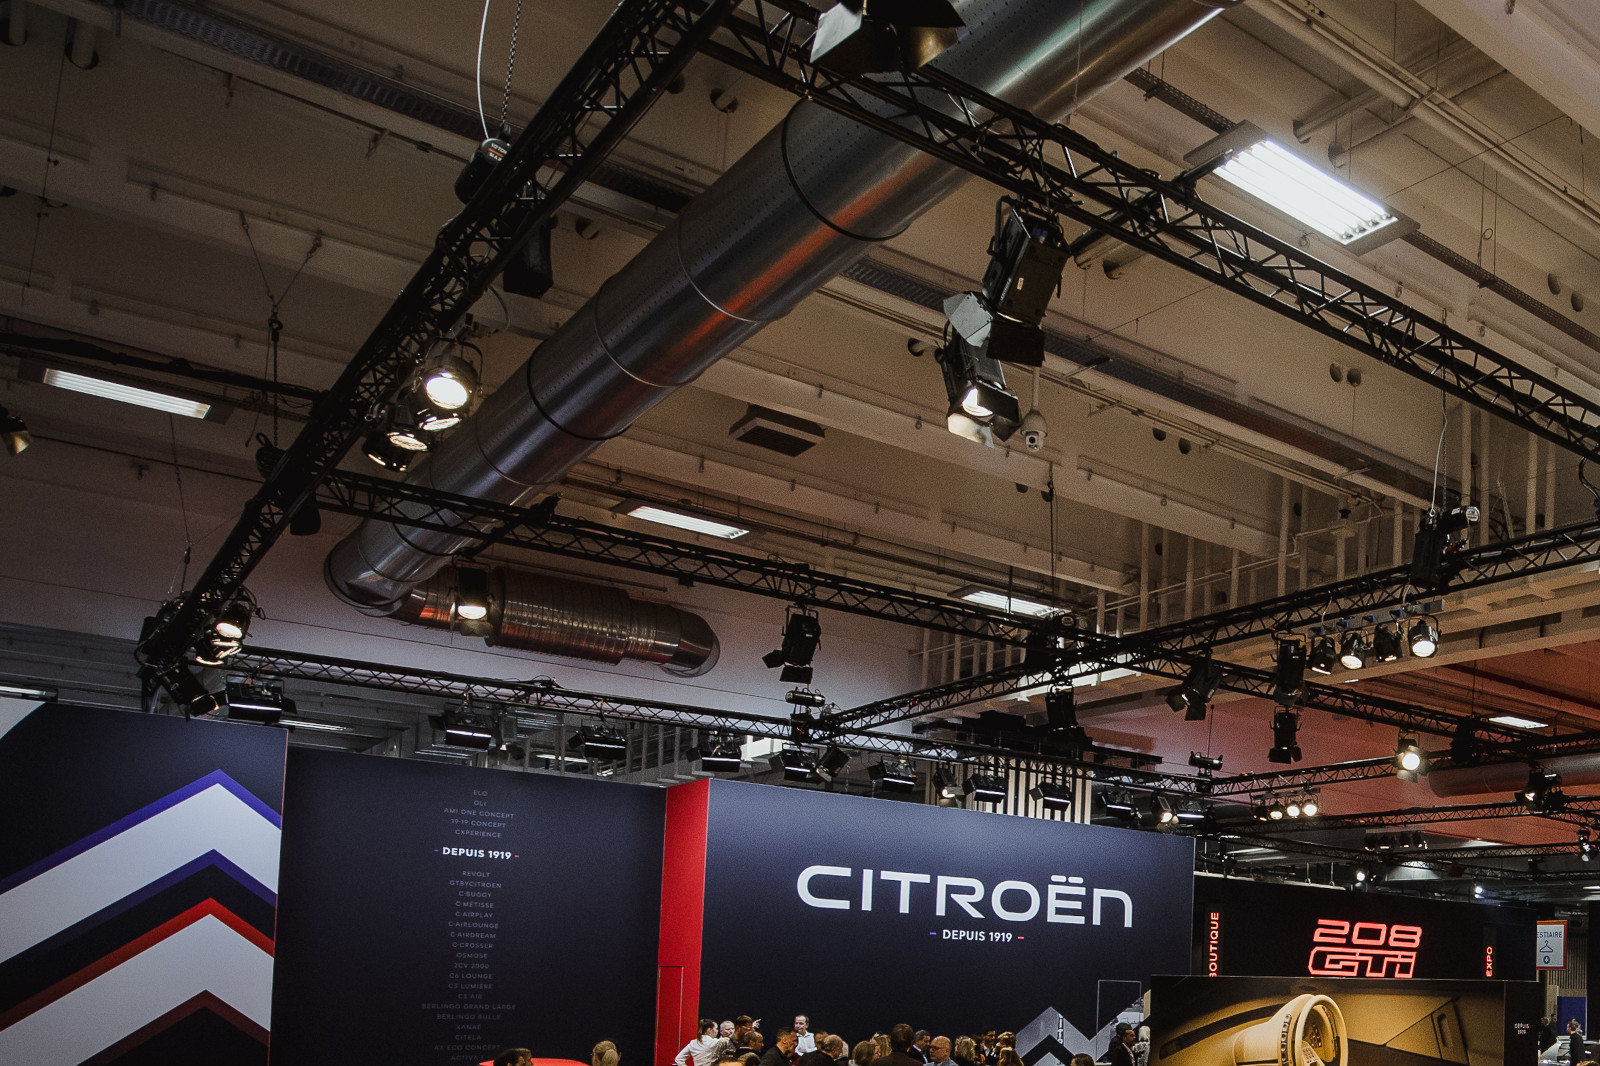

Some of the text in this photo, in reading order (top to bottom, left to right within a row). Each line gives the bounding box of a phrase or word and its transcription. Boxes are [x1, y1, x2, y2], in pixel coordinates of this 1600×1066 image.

[461, 808, 477, 816] ONE
[479, 810, 514, 819] CONCEPT
[470, 820, 506, 828] CONCEPT
[455, 829, 502, 838] CXPERIENCE
[442, 846, 512, 860] DEPUIS 1919
[462, 870, 491, 878] REVOLT
[796, 865, 1133, 928] CITROËN
[942, 929, 1013, 943] DEPUIS 1919
[1313, 918, 1422, 948] 208
[1208, 912, 1220, 977] BOUTIQUE
